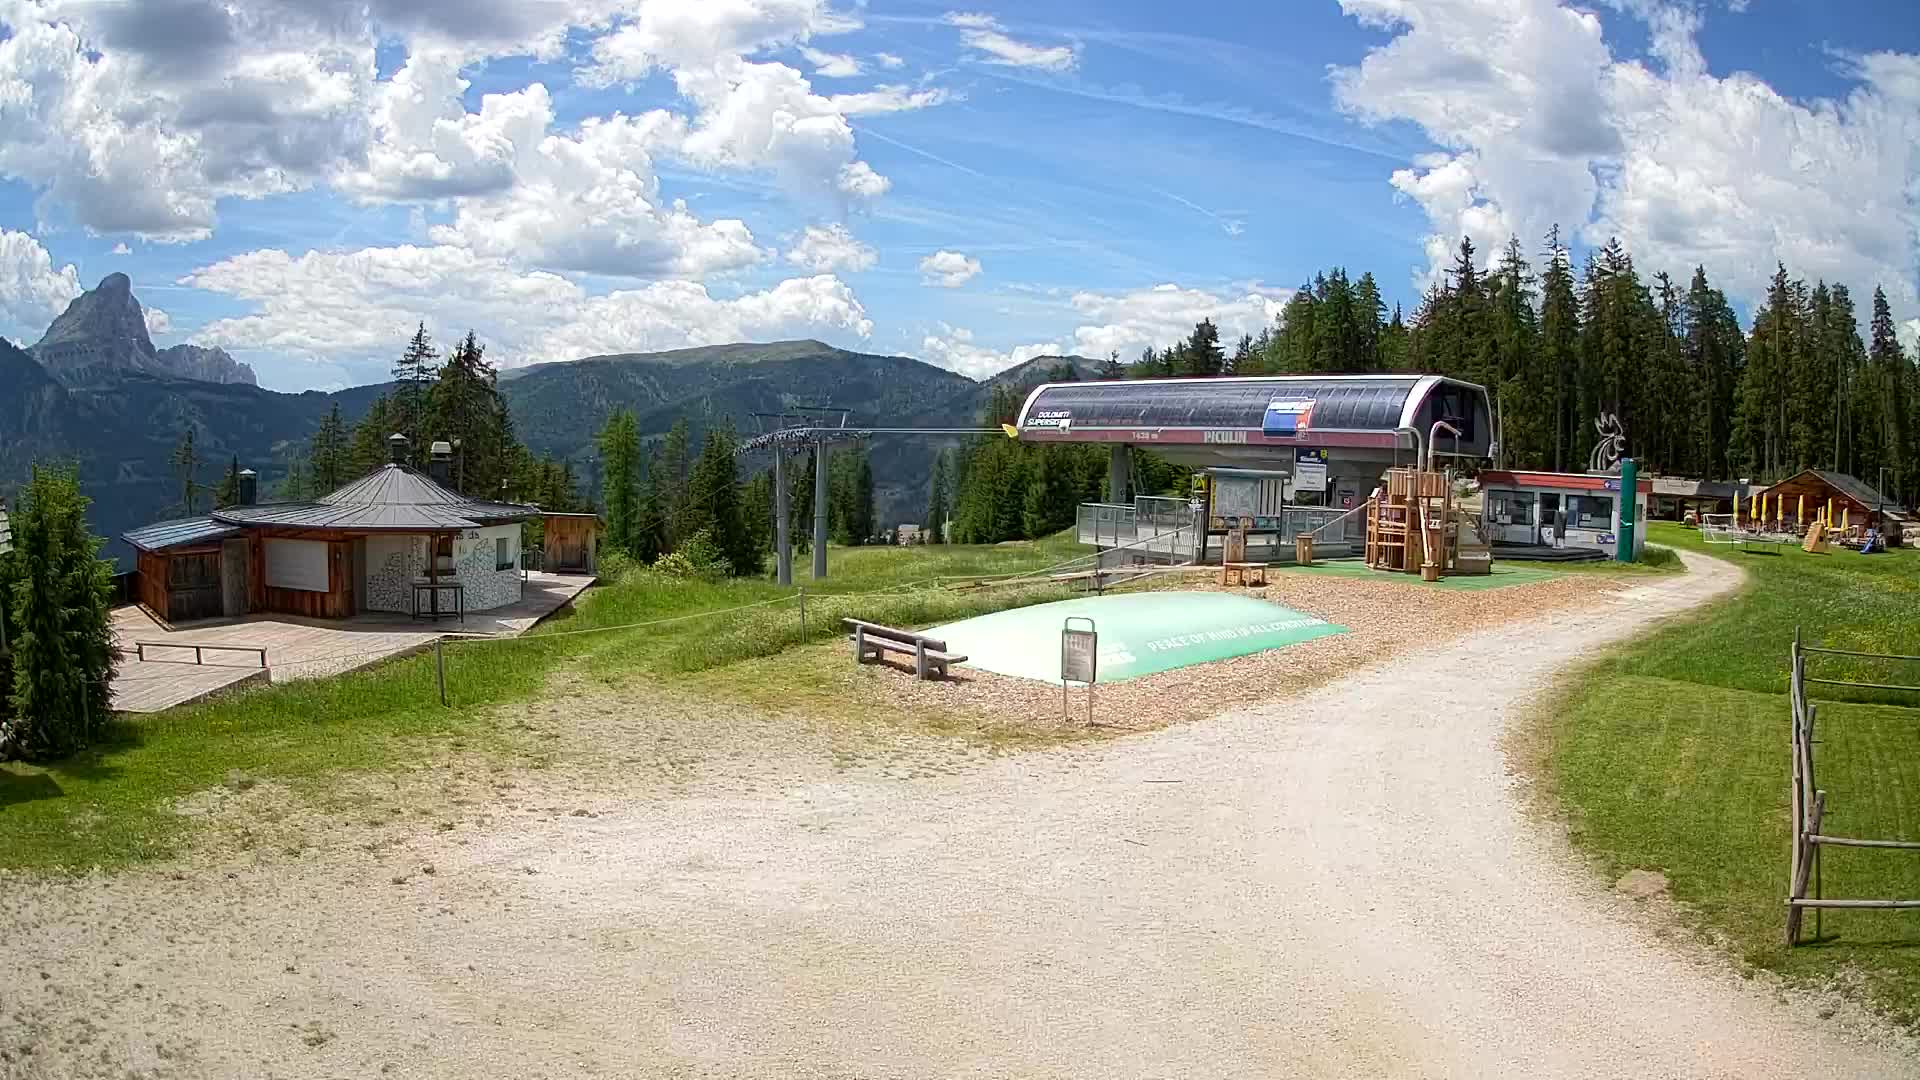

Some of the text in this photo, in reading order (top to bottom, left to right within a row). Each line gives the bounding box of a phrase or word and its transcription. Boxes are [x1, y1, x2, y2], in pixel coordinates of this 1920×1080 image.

[1203, 431, 1247, 443] PICULIN
[1146, 635, 1190, 652] PEACE
[1189, 633, 1206, 645] OF
[1206, 629, 1238, 642] MIND
[1250, 624, 1271, 635] ALL
